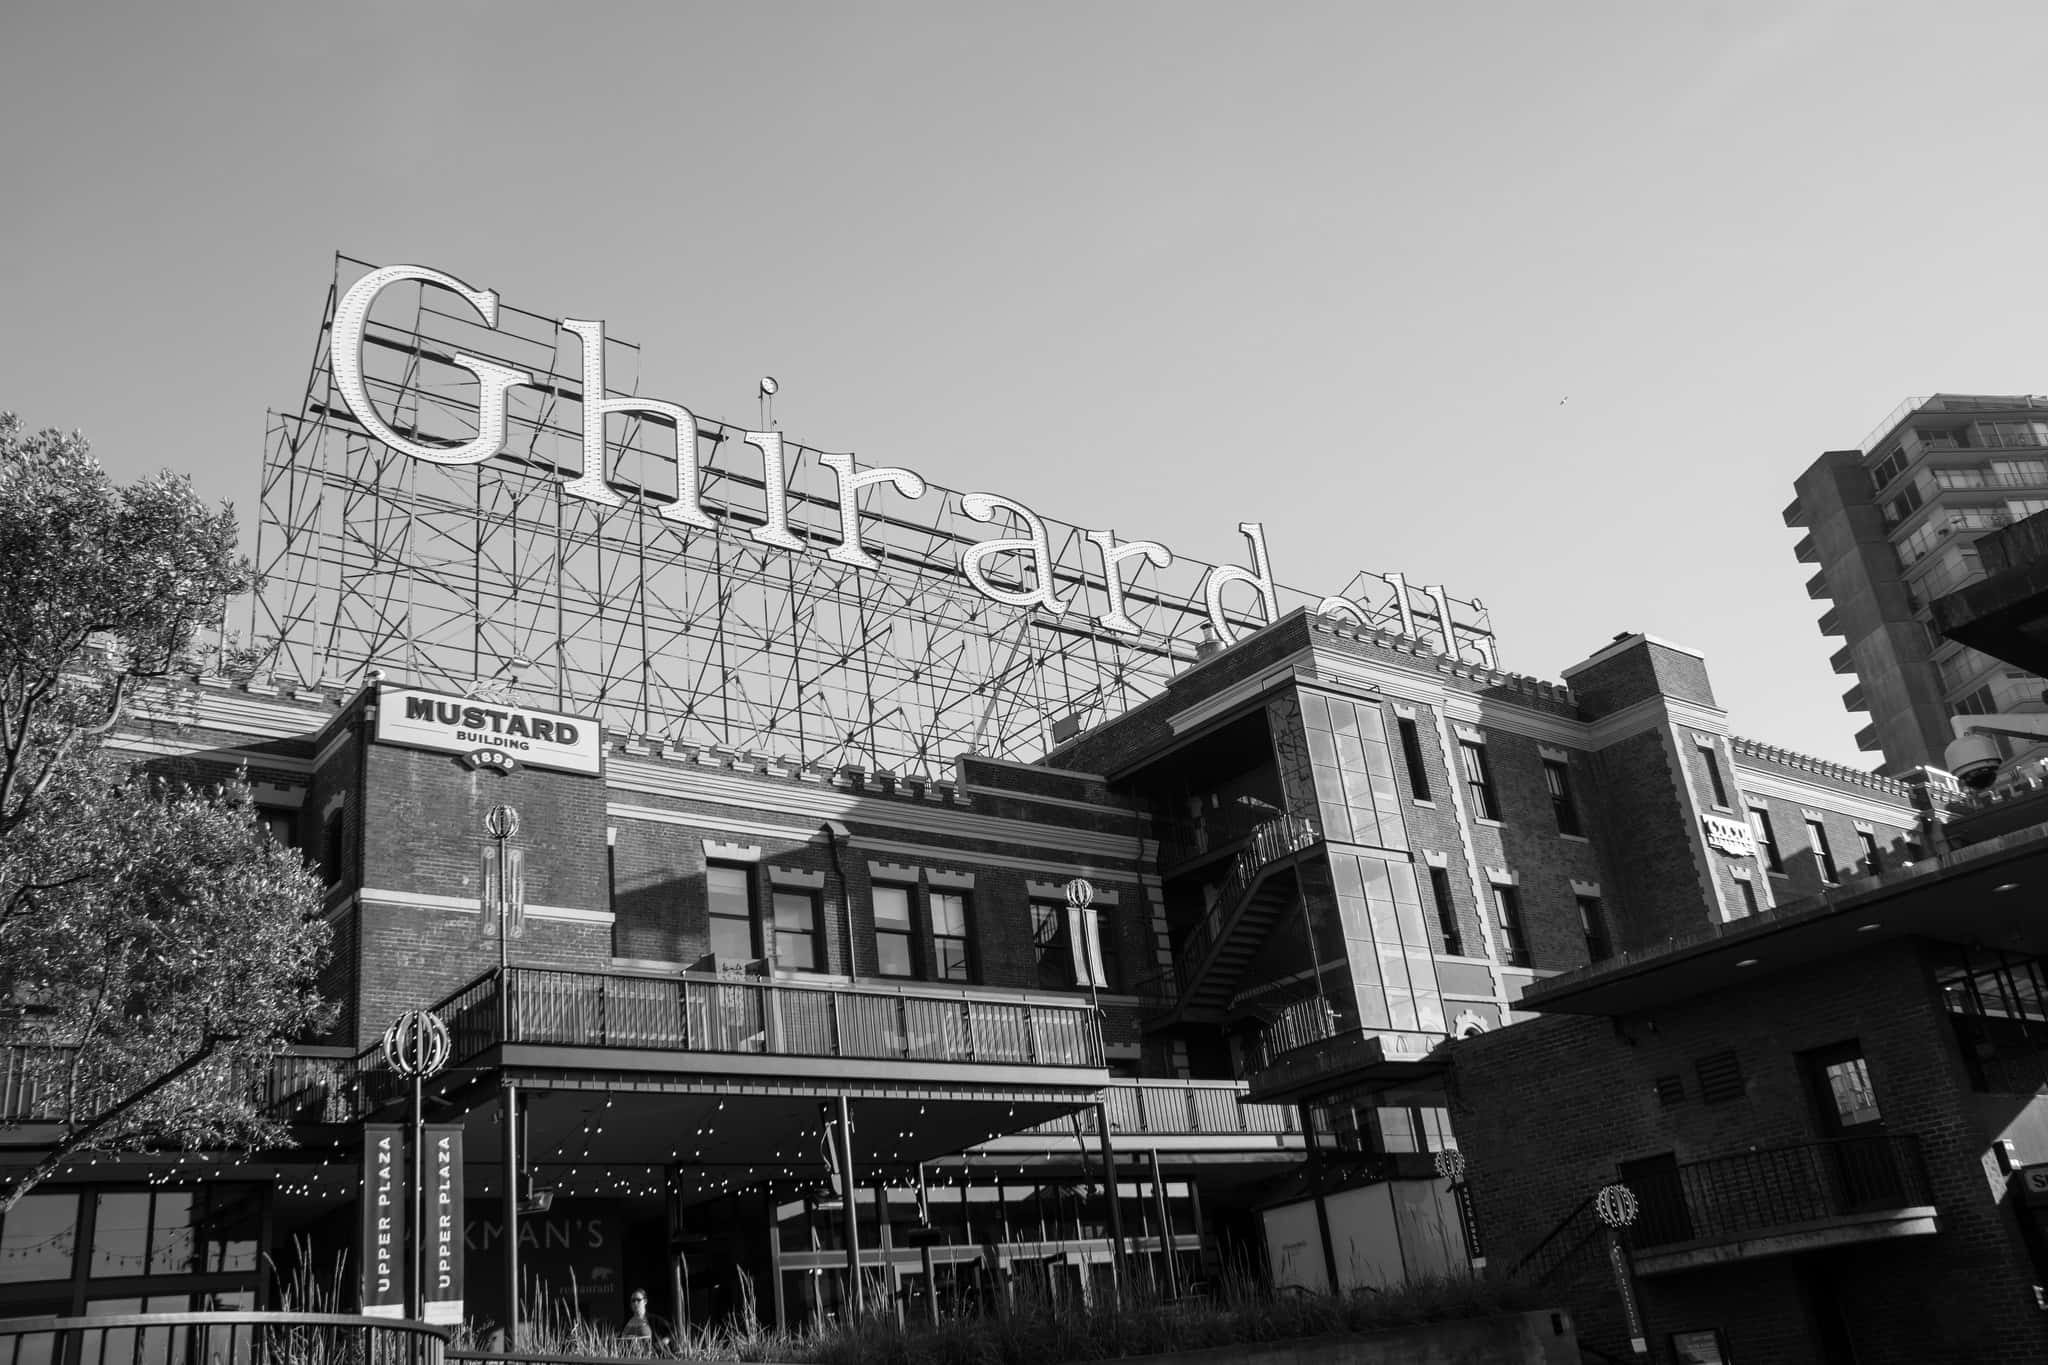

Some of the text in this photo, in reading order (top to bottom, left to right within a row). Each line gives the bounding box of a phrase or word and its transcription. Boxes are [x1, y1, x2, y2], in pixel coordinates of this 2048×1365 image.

[406, 696, 578, 745] MUSTARD
[456, 730, 530, 751] BUILDING
[471, 751, 515, 769] 1899
[377, 1136, 392, 1293] UPPER PLAZA
[438, 1135, 451, 1289] UPPER PLAZA
